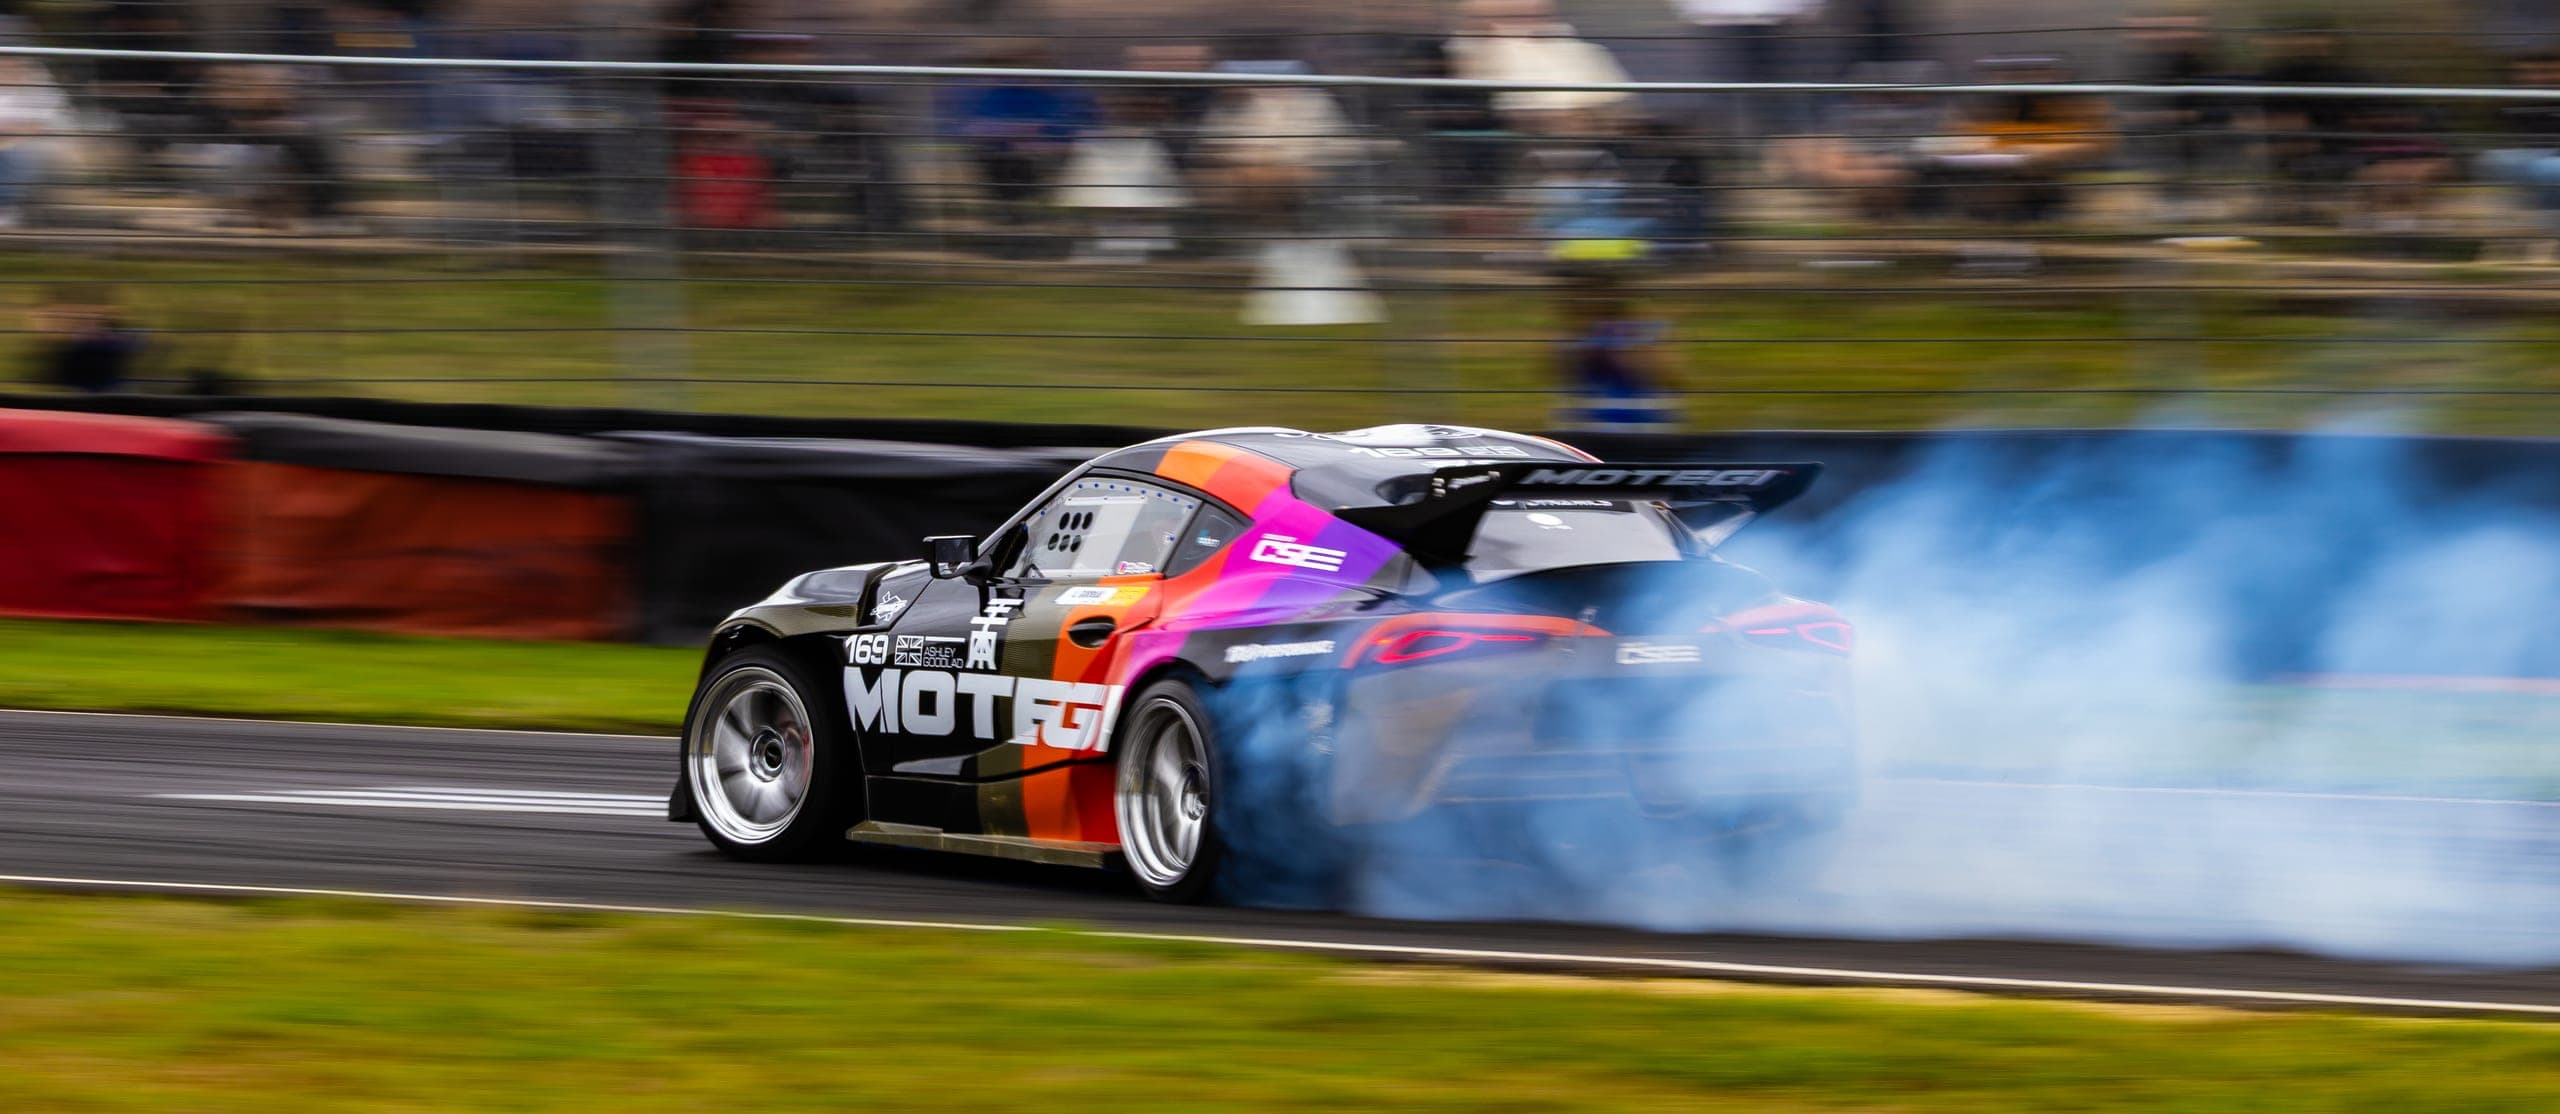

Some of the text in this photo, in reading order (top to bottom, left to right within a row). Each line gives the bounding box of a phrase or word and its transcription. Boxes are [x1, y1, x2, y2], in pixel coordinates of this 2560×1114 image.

[1520, 469, 1778, 485] MOTEGI
[1250, 539, 1347, 572] CSE
[845, 634, 889, 665] 169
[924, 647, 956, 656] ASHLEY
[923, 658, 964, 669] GOODLAD
[843, 666, 1125, 753] MOTEGI
